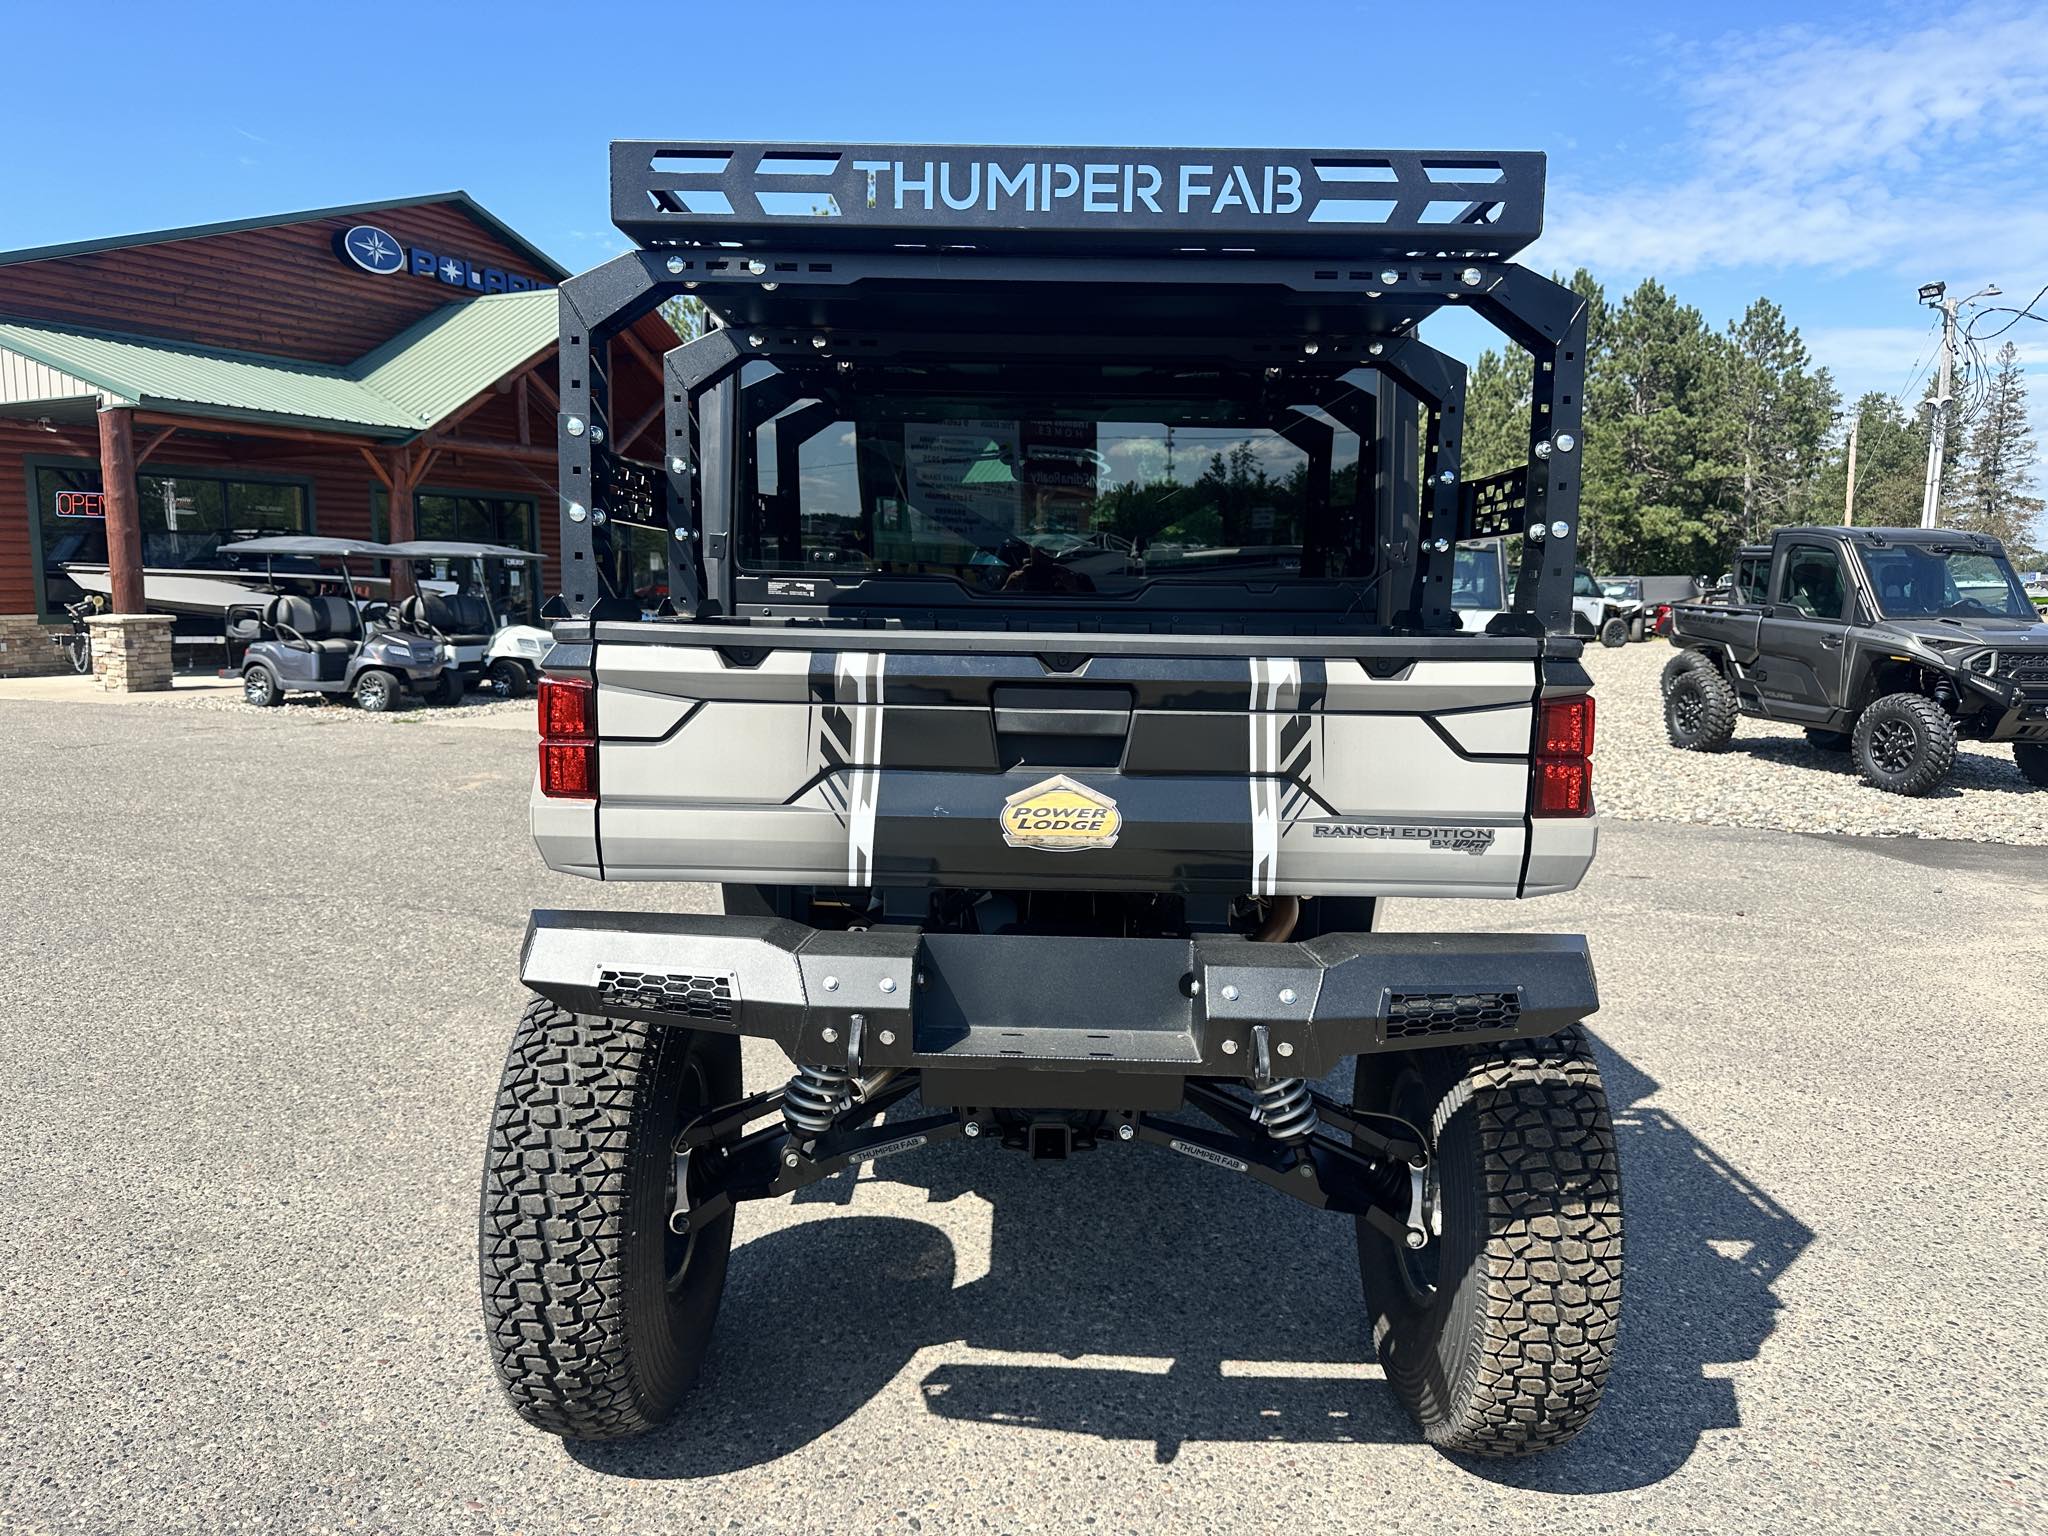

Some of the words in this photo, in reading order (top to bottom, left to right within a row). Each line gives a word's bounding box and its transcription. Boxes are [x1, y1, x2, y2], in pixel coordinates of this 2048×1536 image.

[853, 160, 1163, 213] THUMPER
[1178, 164, 1303, 214] FAB
[409, 247, 558, 294] POLAR
[1012, 807, 1108, 819] POWER
[1017, 818, 1104, 831] LODGE
[1315, 825, 1395, 837] RANCH
[1402, 827, 1492, 839] EDITION
[857, 1143, 902, 1160] THUMPER
[900, 1138, 919, 1150] FAB
[1179, 1143, 1222, 1163] THUMPER
[1220, 1157, 1240, 1169] FAB
